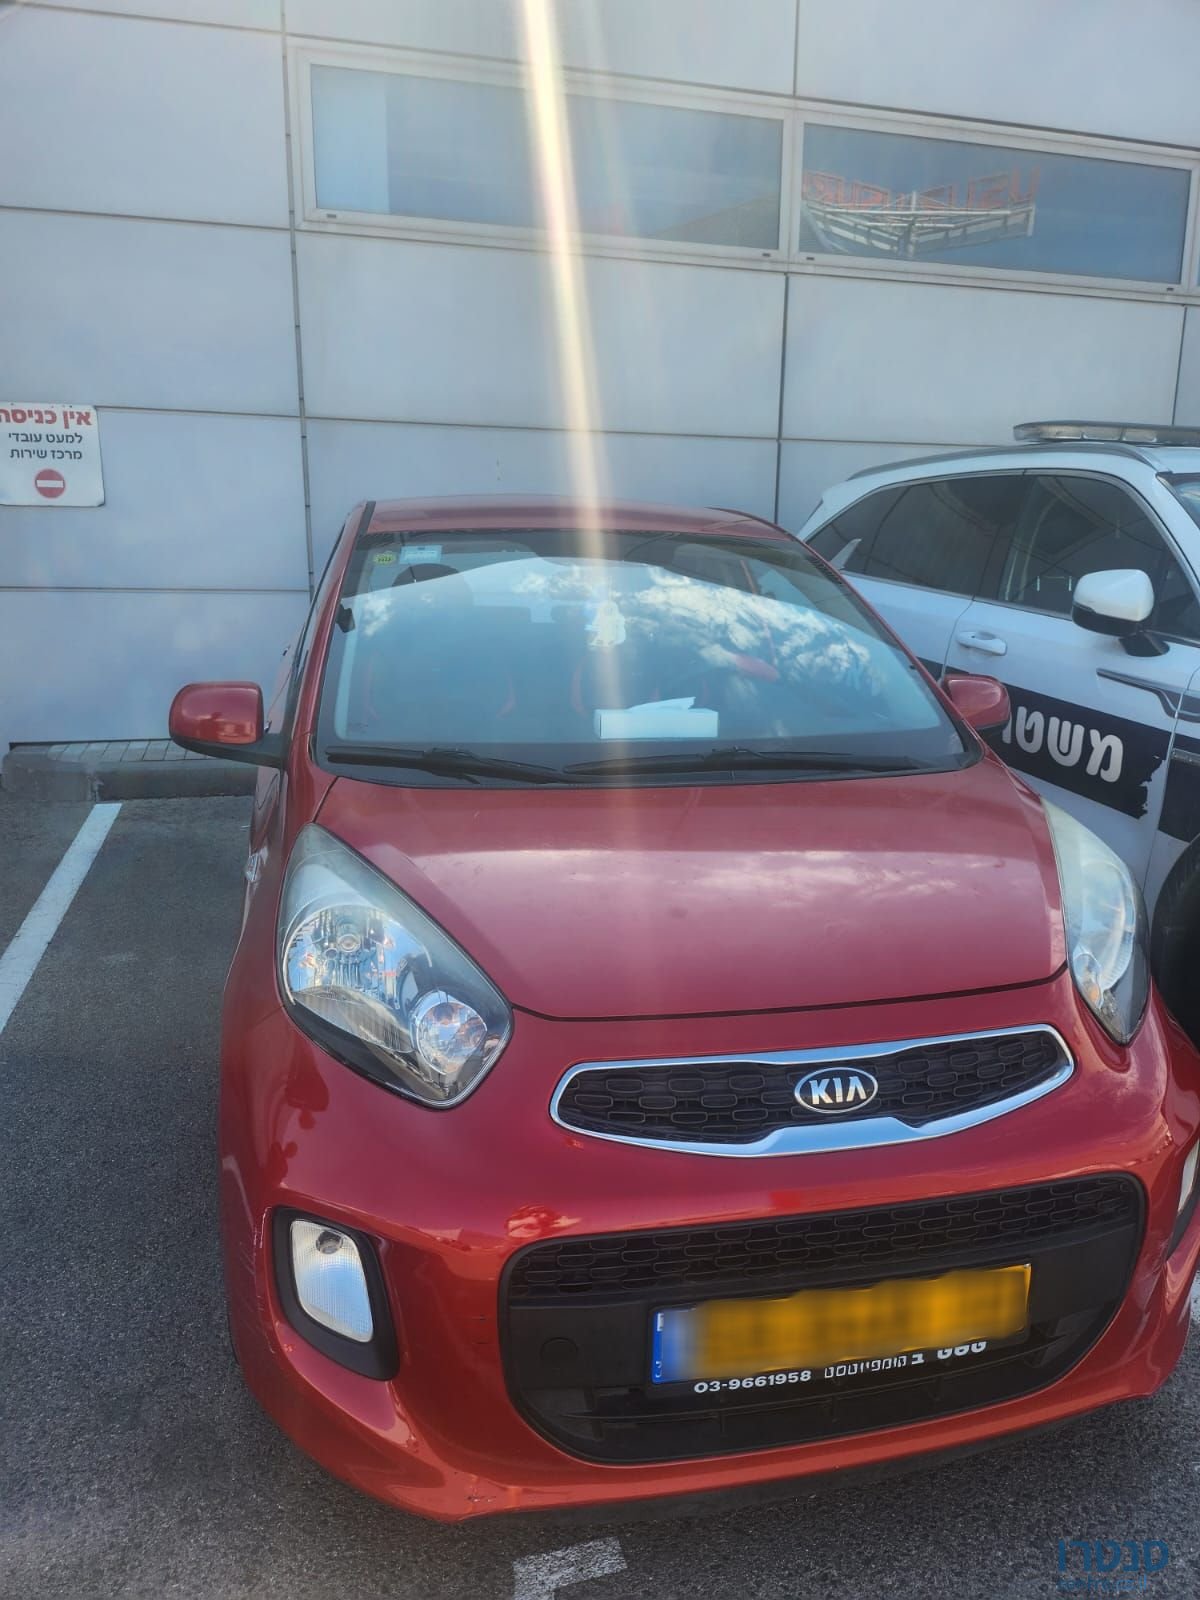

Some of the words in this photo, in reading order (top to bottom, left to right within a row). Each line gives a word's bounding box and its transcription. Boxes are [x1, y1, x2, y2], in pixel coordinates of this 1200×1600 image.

[63, 410, 92, 429] אין
[9, 432, 42, 443] עובדי
[46, 432, 83, 444] למעט
[10, 448, 47, 459] שירות
[51, 449, 82, 460] מרכז
[809, 1076, 867, 1105] KIA
[694, 1370, 812, 1393] 03-9661958
